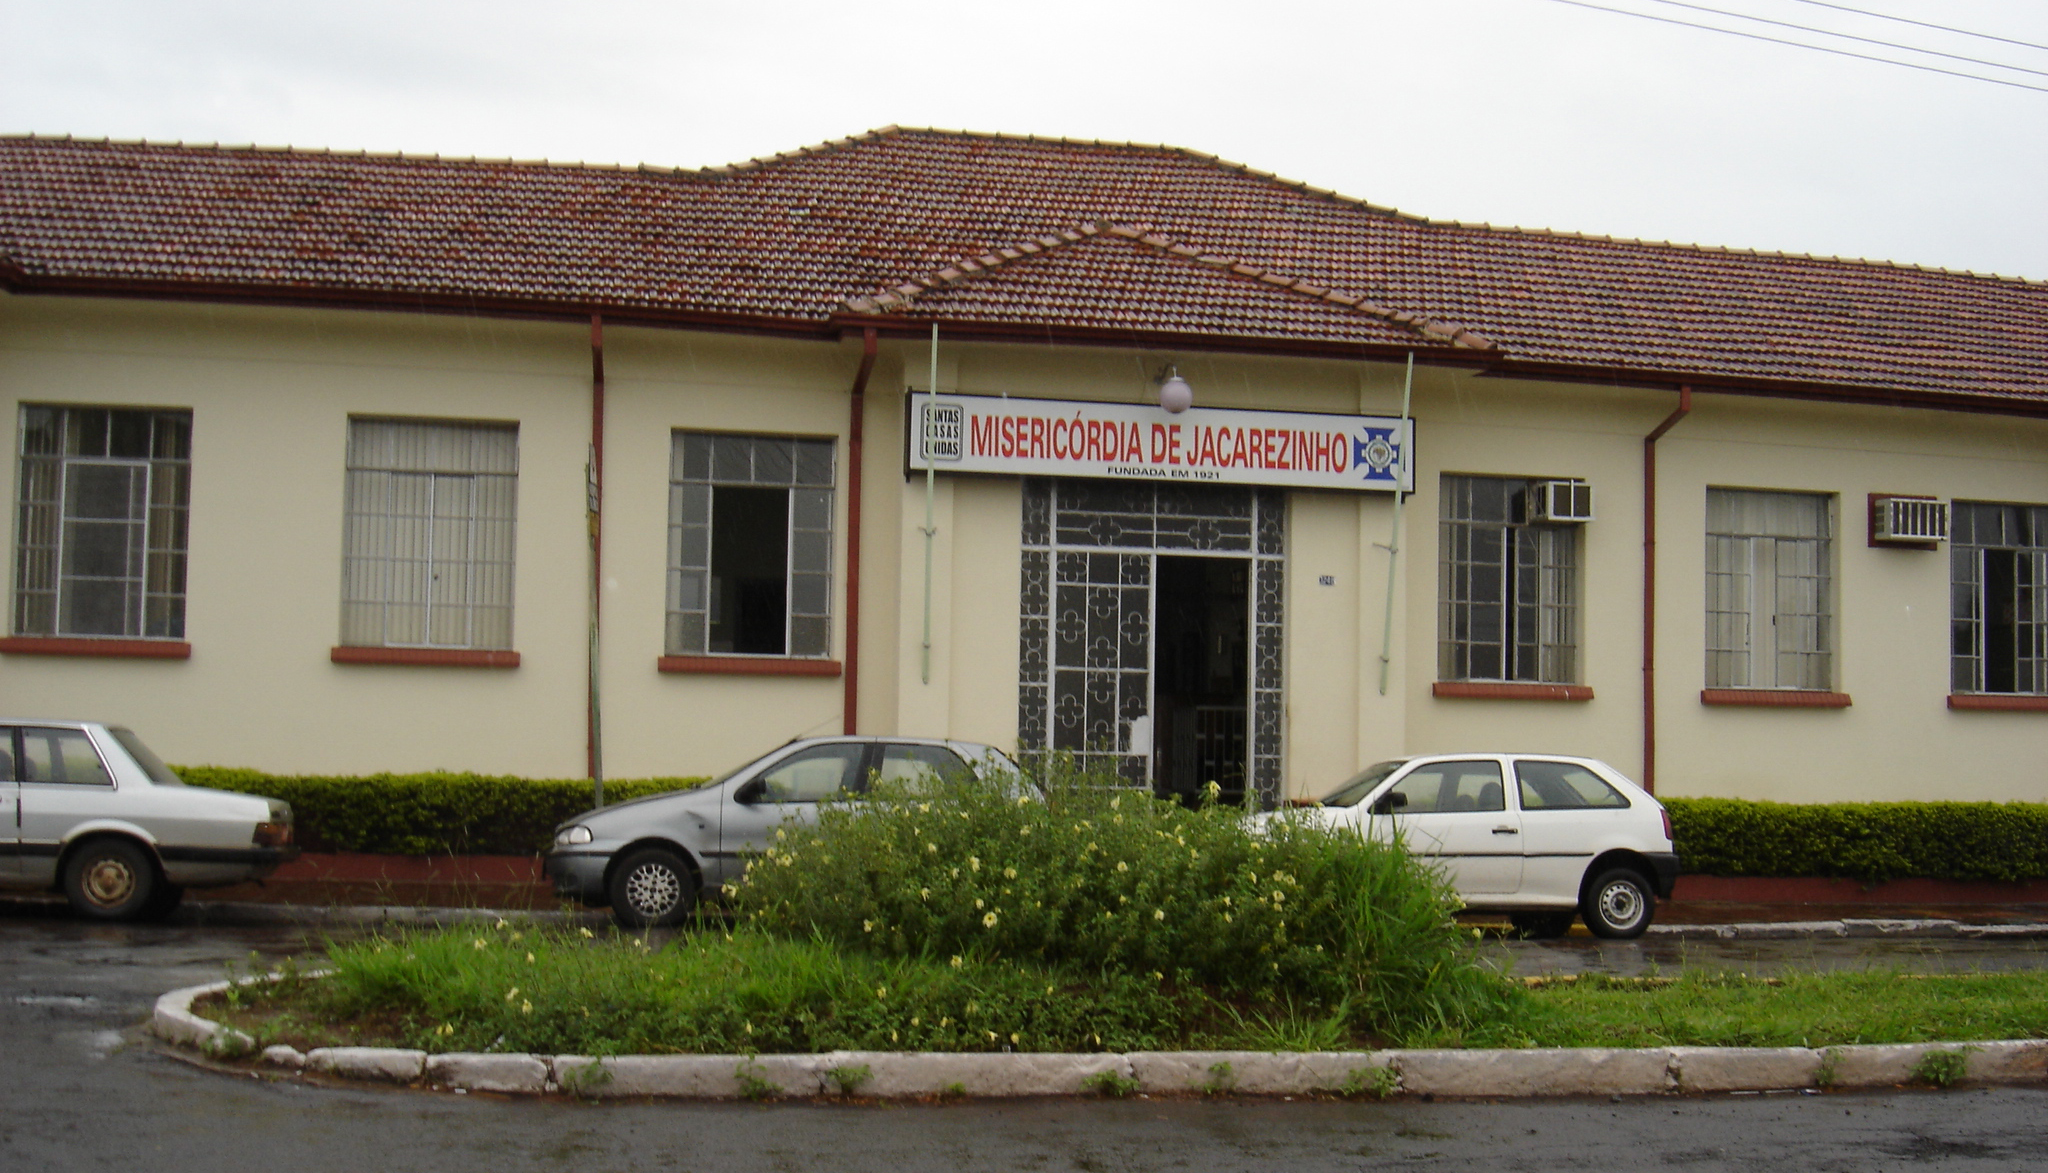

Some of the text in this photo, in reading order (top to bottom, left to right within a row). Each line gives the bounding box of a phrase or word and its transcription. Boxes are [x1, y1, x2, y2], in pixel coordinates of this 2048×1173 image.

[971, 410, 1348, 474] MISERICÓRDIA DE JACAREZINHO
[1107, 466, 1221, 480] FUNDADA EM 1921
